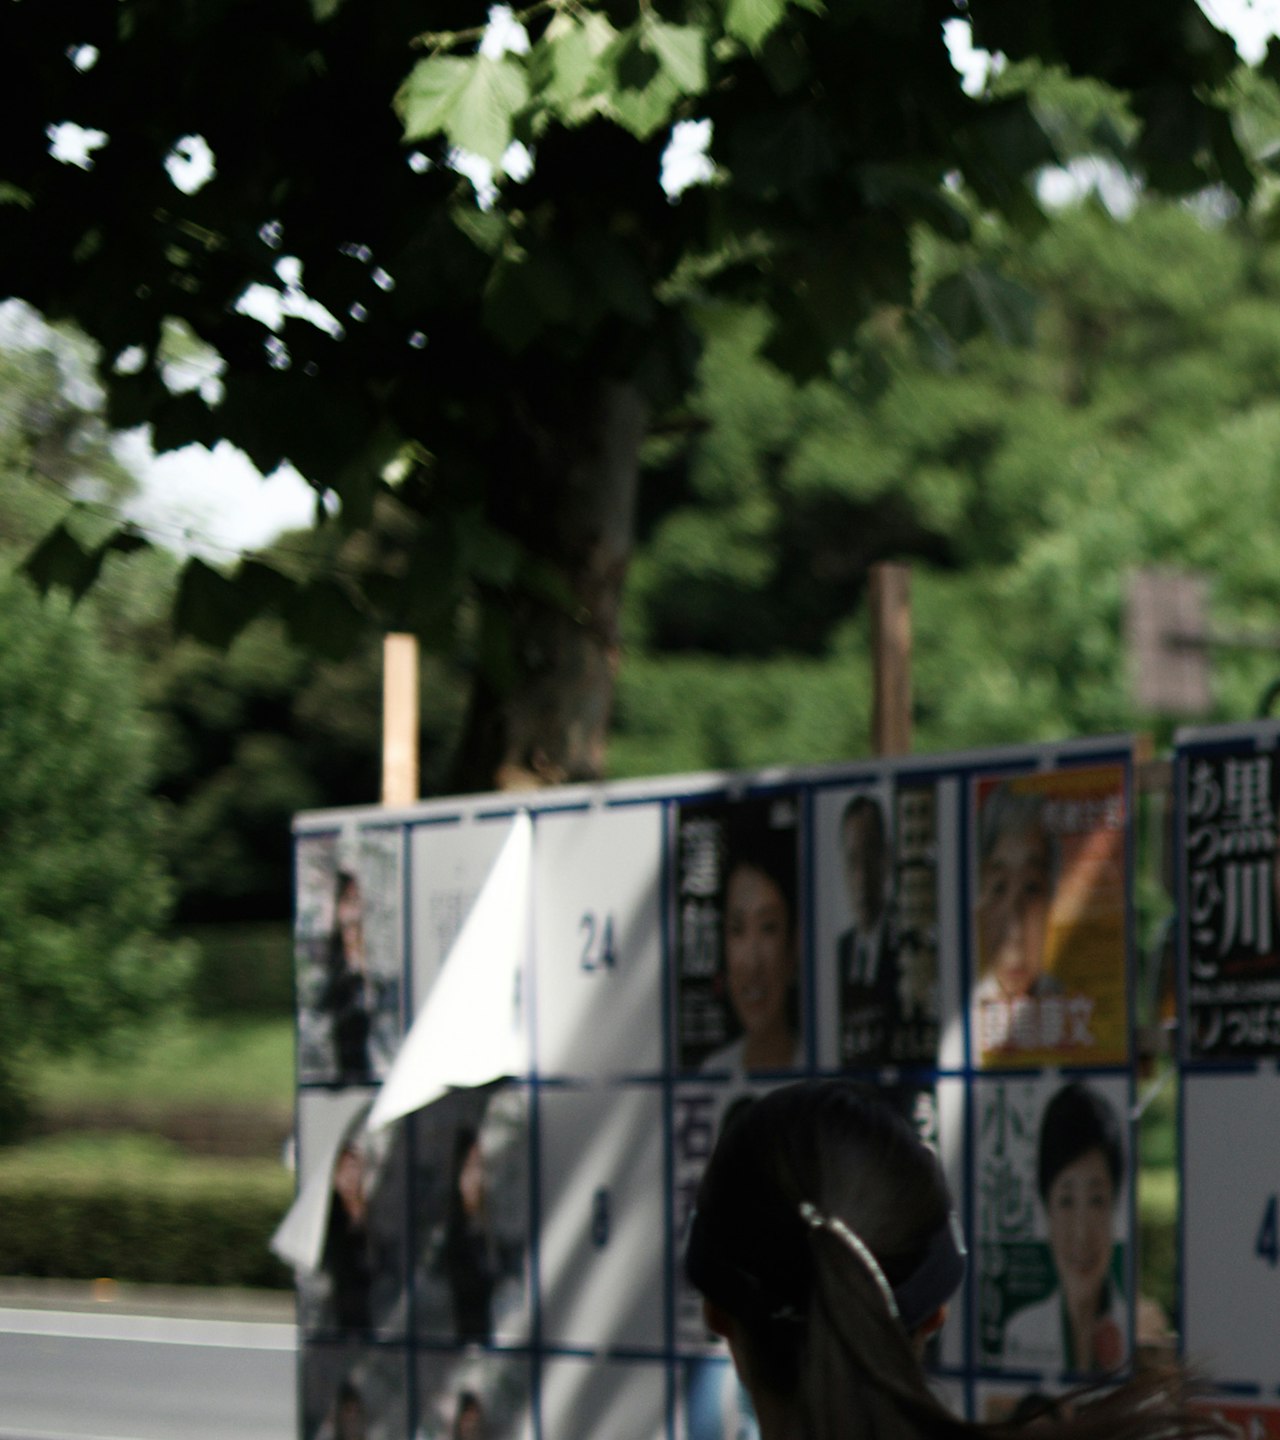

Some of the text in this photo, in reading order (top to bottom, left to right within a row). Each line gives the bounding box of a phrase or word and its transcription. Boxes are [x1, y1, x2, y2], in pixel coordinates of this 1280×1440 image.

[579, 911, 617, 971] 24
[1187, 760, 1221, 980] あつひこ
[1220, 756, 1276, 955] 黒川
